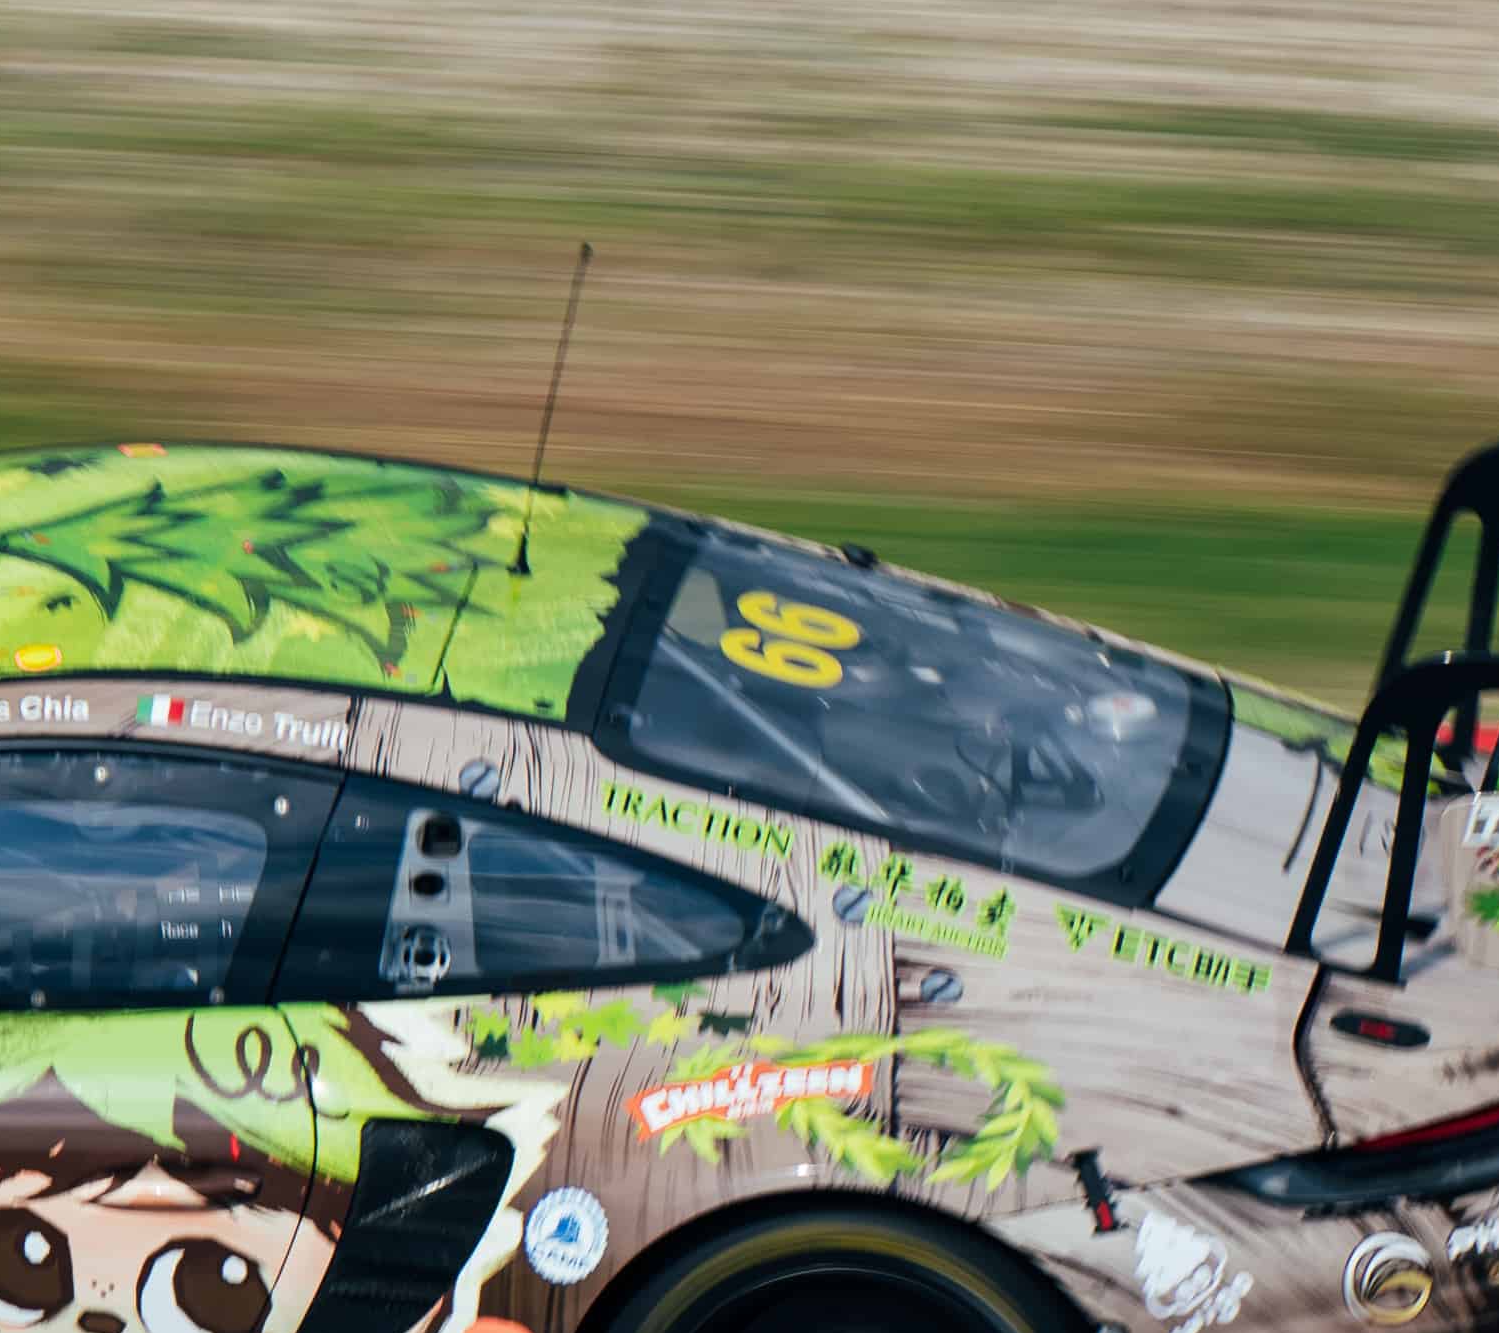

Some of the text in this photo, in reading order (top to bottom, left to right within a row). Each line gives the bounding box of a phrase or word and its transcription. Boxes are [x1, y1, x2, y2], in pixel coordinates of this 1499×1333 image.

[720, 590, 861, 689] 66
[19, 695, 90, 723] Chia
[190, 700, 264, 734] Enzo
[602, 779, 794, 862] TRACTION
